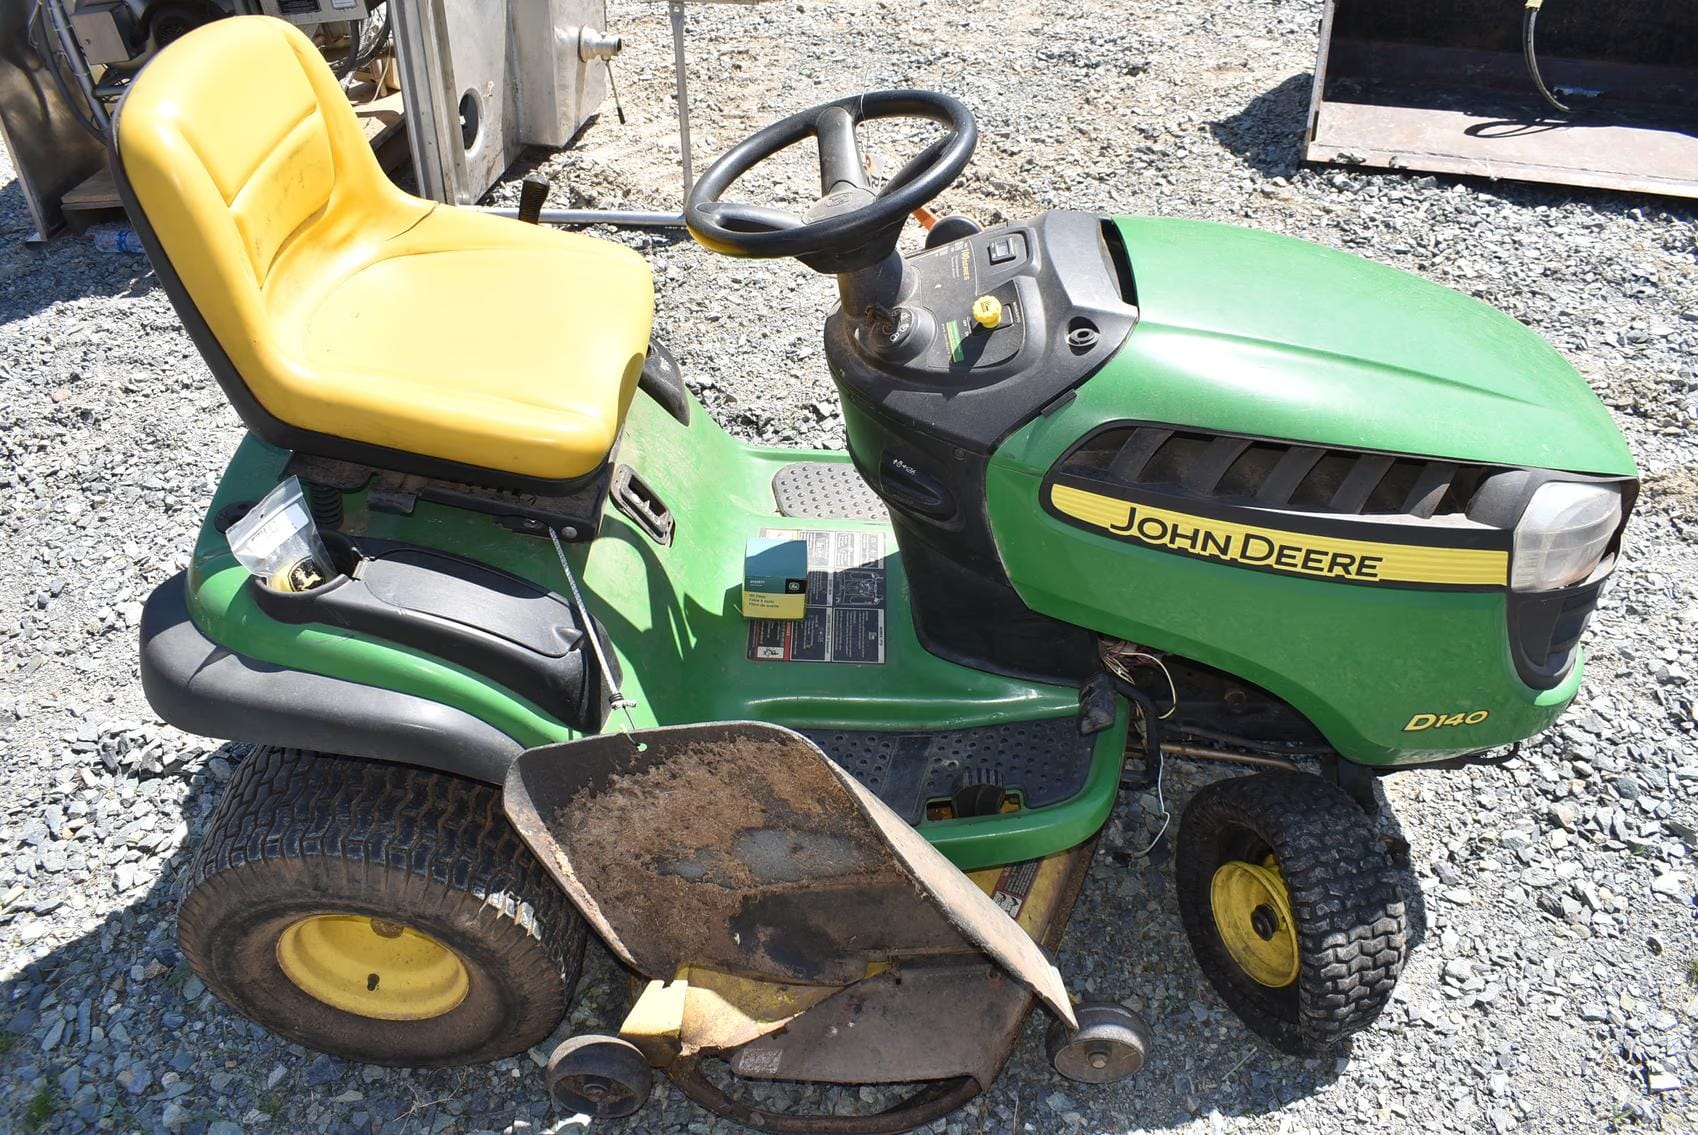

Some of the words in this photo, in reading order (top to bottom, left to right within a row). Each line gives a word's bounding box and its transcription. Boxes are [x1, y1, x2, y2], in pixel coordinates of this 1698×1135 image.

[1110, 507, 1232, 556] JOHN
[1239, 533, 1383, 578] DEERE
[1401, 709, 1489, 732] D140
